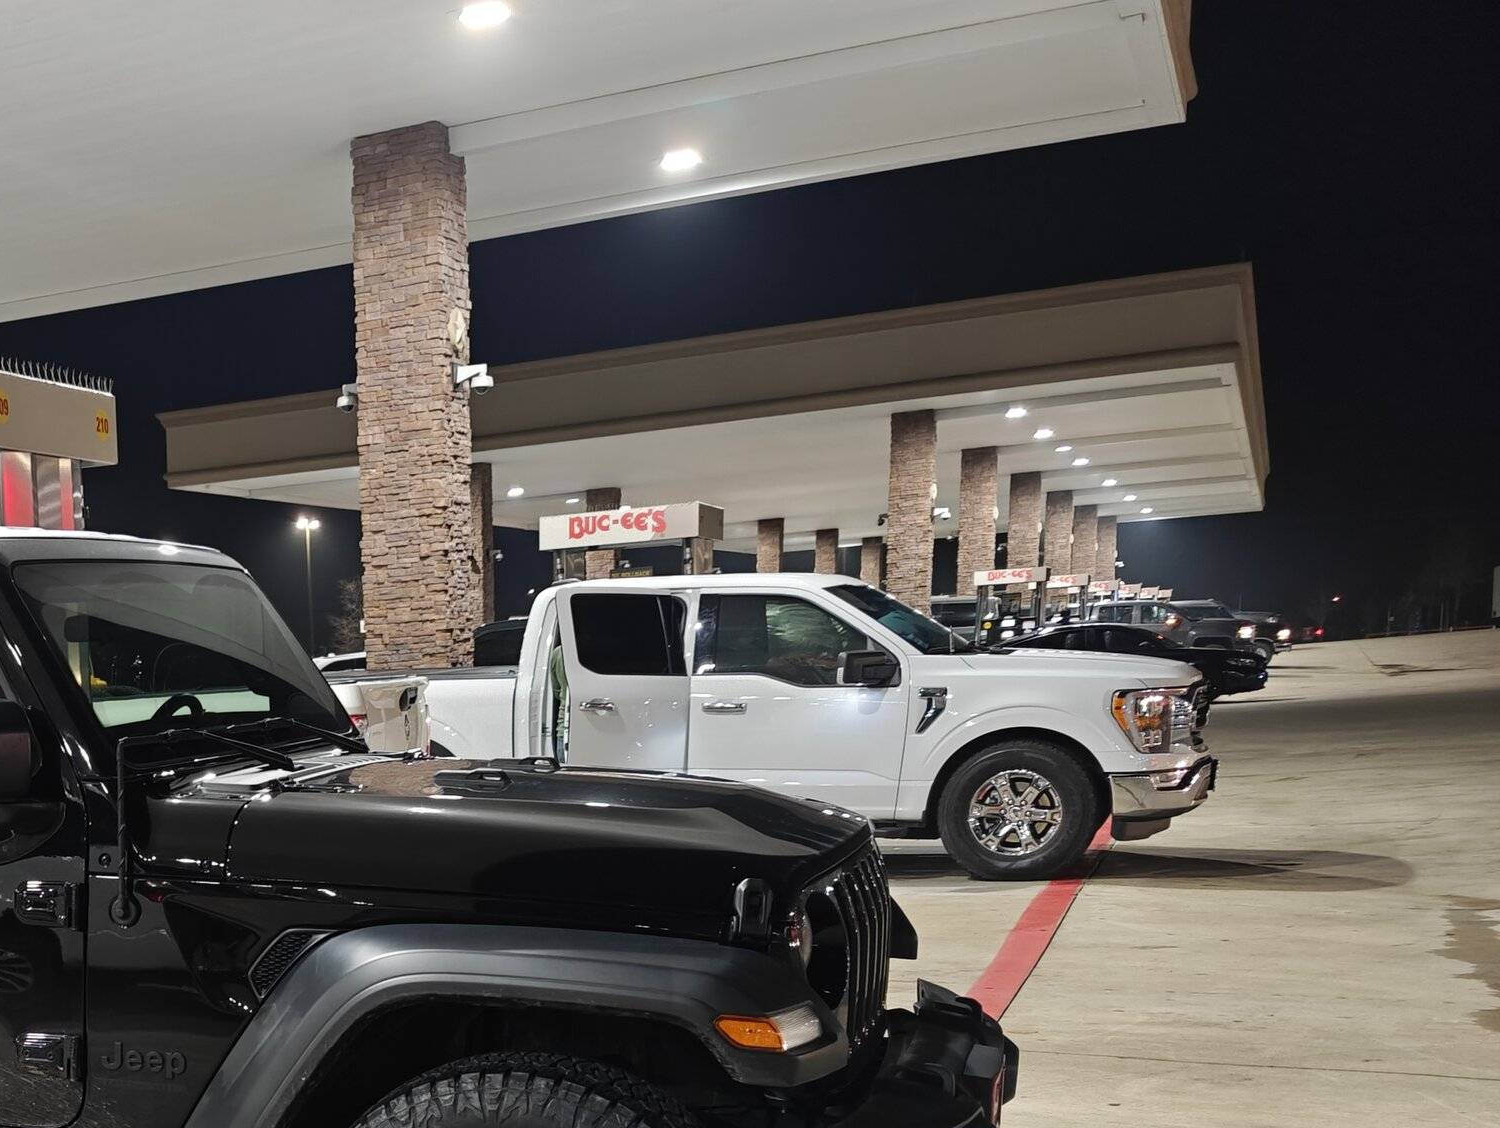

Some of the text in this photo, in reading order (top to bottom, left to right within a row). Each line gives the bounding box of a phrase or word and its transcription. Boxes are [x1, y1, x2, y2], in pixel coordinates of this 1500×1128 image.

[95, 416, 109, 434] 210
[569, 509, 667, 539] BUC-EE'S
[102, 1041, 188, 1079] Jeep
